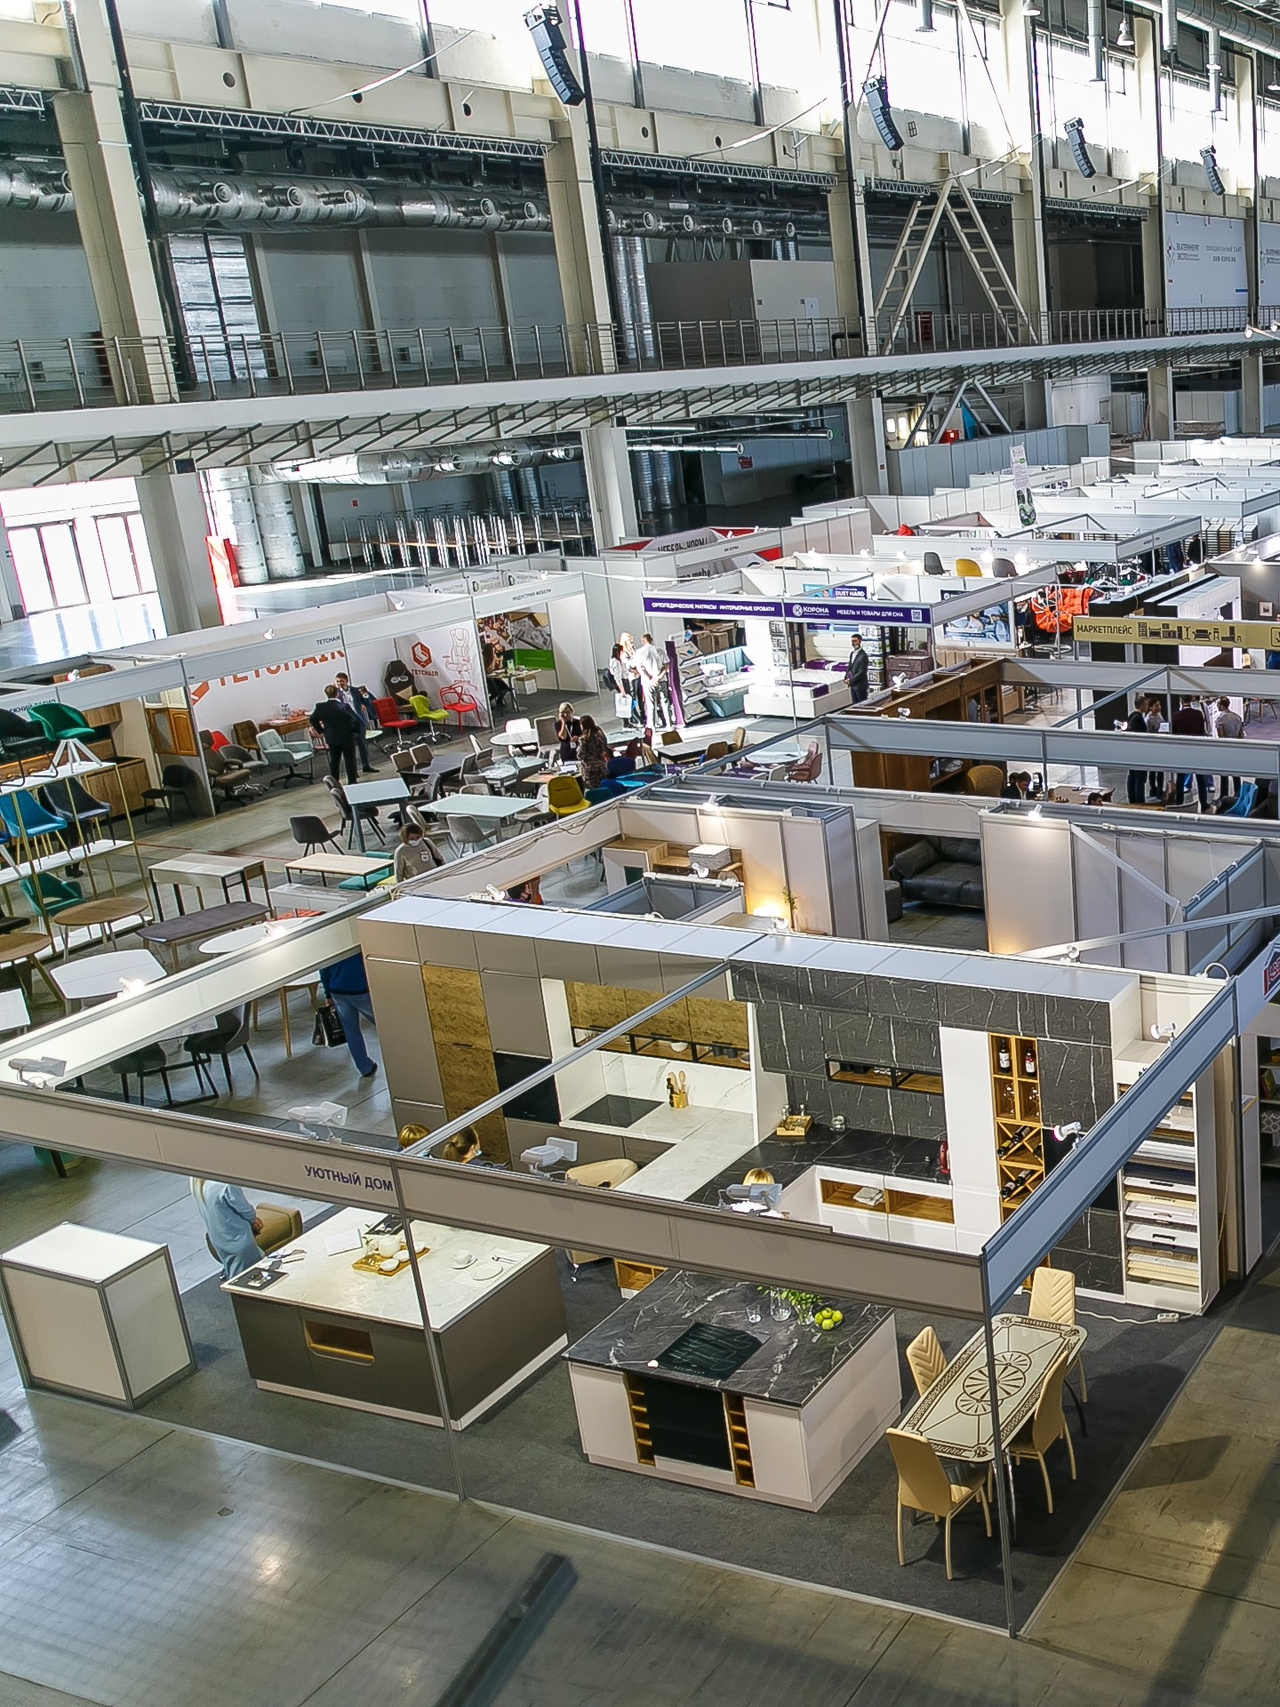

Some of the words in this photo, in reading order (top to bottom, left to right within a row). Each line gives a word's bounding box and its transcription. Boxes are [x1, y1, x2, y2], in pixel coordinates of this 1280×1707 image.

[1077, 624, 1132, 635] МАРКЕТПЛЕЙС
[316, 635, 341, 646] TETCHAIR
[411, 669, 439, 678] TETCHAIR
[305, 1165, 361, 1186] УЮТНЫЙ
[365, 1177, 393, 1192] ДОМ
